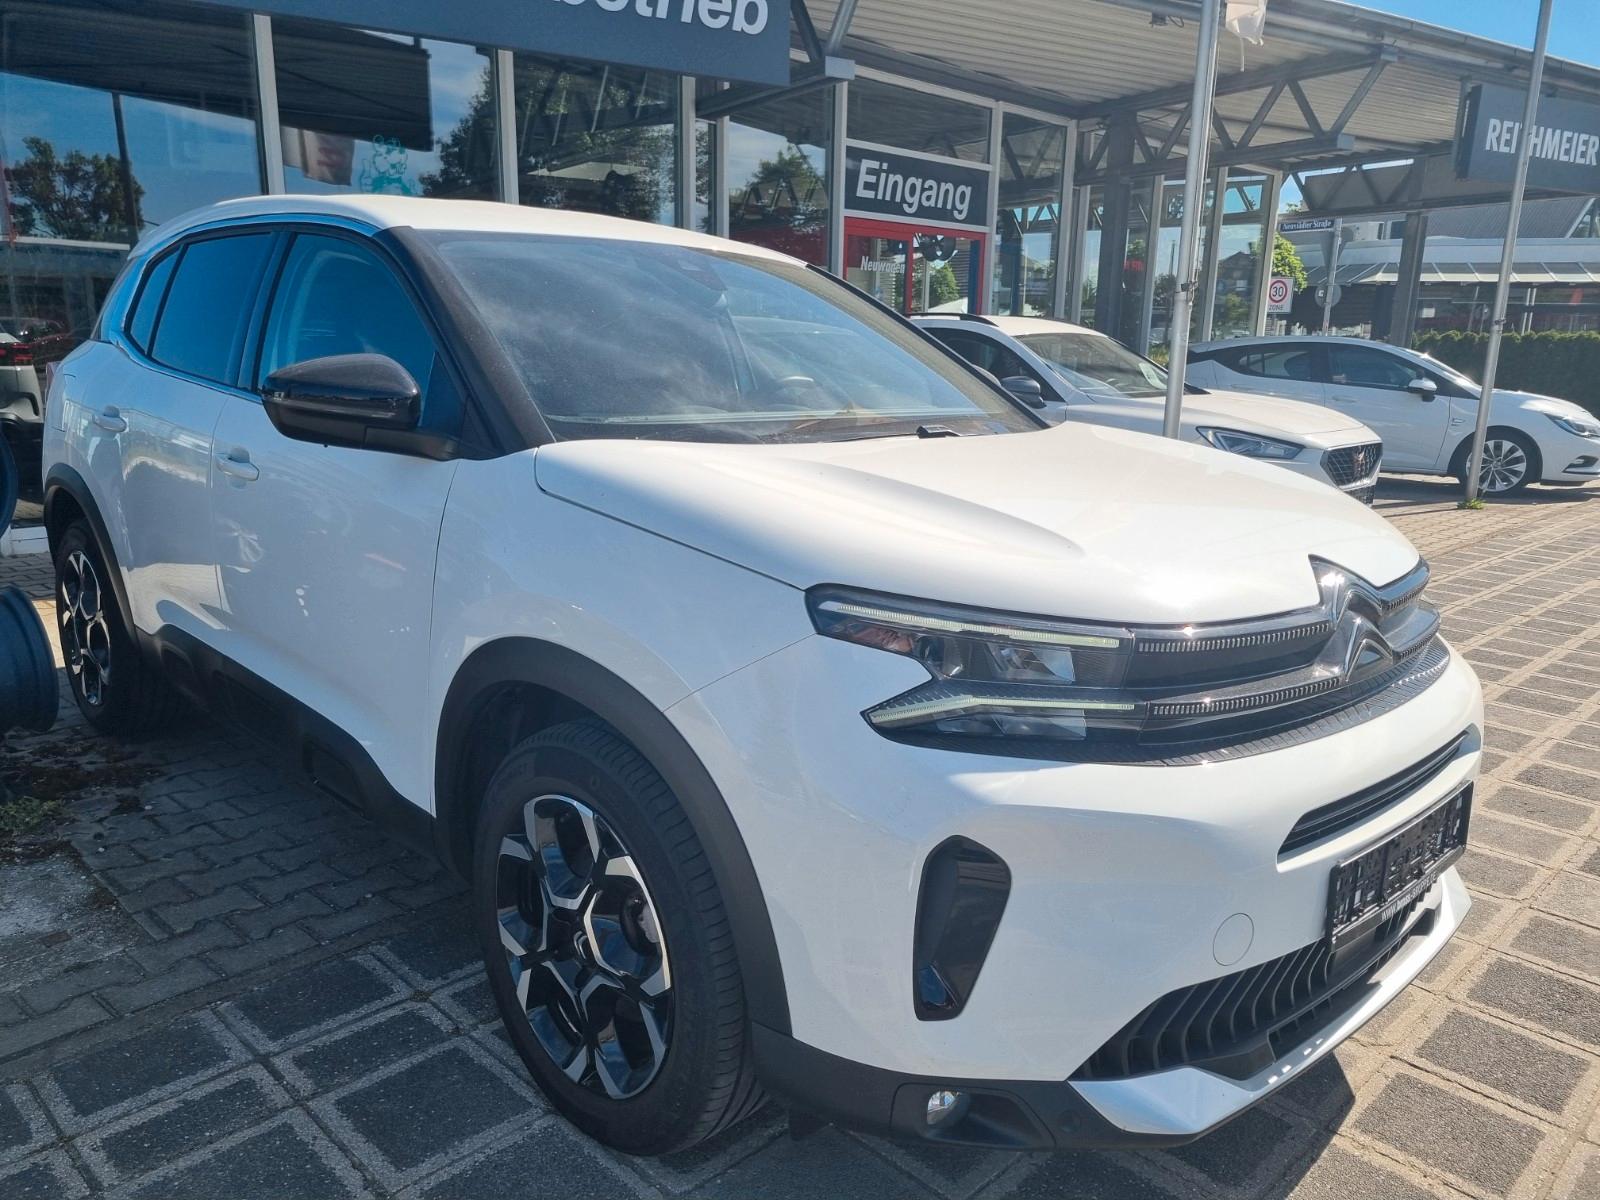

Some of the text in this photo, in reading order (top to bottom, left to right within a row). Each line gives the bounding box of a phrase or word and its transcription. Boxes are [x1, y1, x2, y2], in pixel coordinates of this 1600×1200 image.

[1485, 118, 1600, 166] REIHMEIER
[856, 158, 972, 220] Eingang
[860, 255, 906, 274] Neuwagen
[1272, 286, 1284, 297] 30
